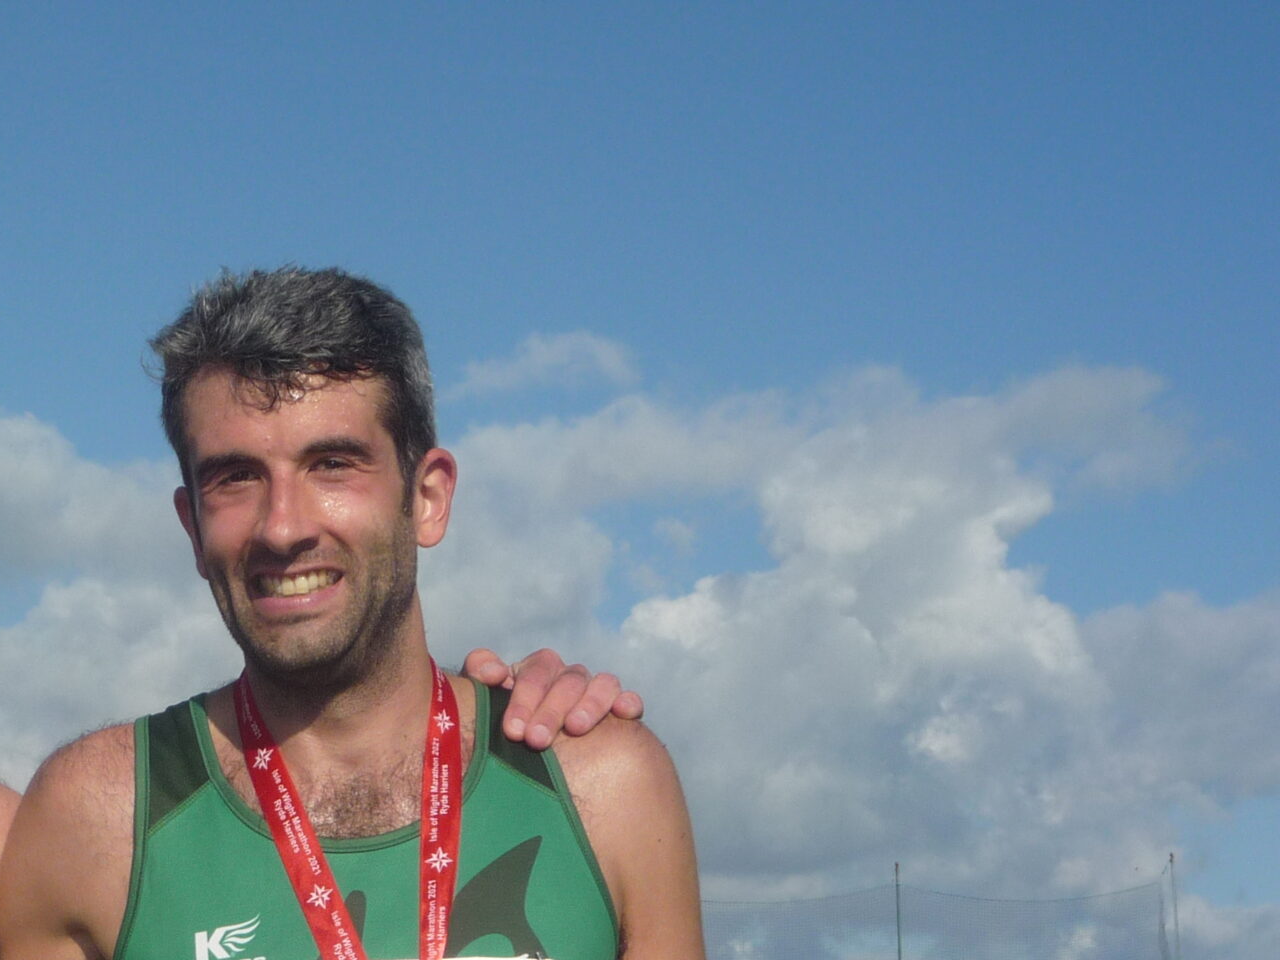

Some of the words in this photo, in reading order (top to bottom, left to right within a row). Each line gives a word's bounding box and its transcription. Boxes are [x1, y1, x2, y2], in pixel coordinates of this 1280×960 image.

[431, 755, 439, 793] Marathon
[440, 765, 448, 795] Harriers
[430, 793, 439, 817] Wight
[440, 796, 448, 815] Ryde
[271, 770, 281, 784] Isle
[277, 784, 285, 794] of
[281, 792, 297, 818] Wight
[292, 817, 311, 856] Marathon
[308, 856, 321, 876] 2021
[273, 800, 285, 820] Ryde
[283, 820, 300, 853] Harriers
[430, 818, 437, 828] of
[428, 880, 436, 899] 2021
[331, 911, 340, 927] Isle
[338, 928, 346, 938] of
[427, 900, 436, 941] Marathon
[437, 906, 446, 940] Harriers
